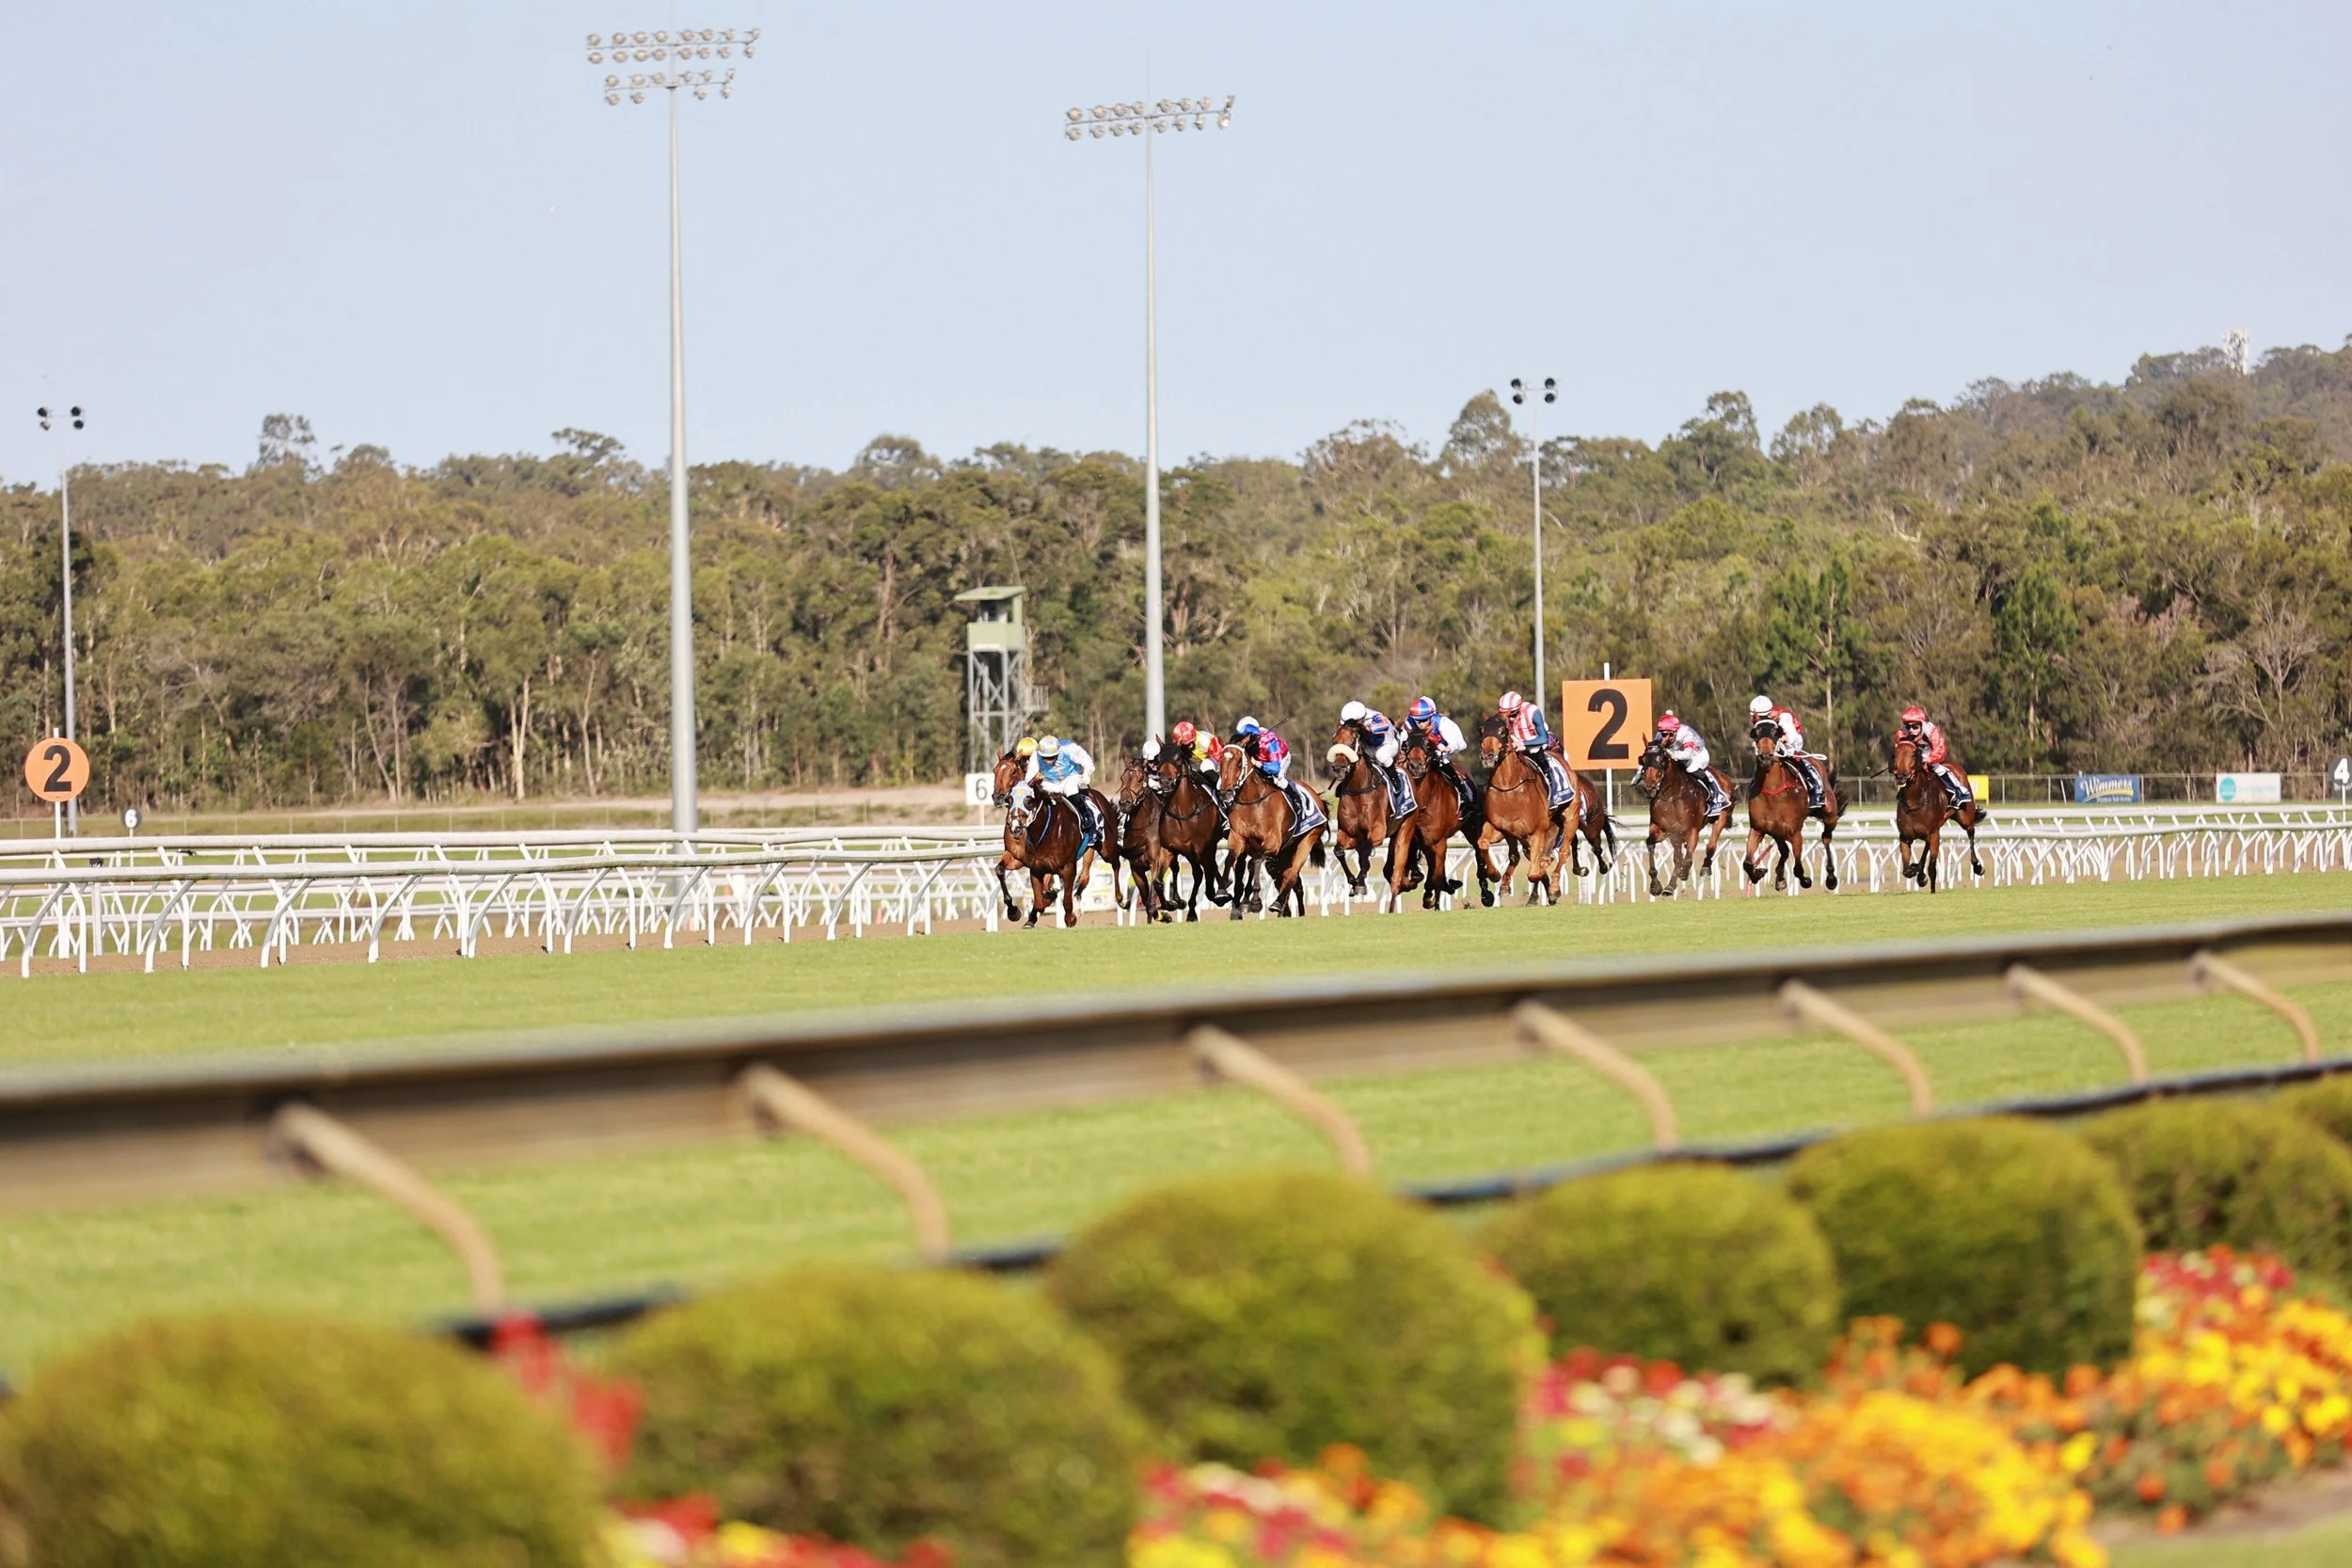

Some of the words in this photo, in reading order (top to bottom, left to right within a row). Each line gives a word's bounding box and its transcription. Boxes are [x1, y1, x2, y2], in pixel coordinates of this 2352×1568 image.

[1587, 689, 1629, 760] 2
[43, 745, 72, 792] 2
[2334, 757, 2350, 784] 4
[976, 778, 988, 800] 6
[124, 809, 137, 828] 6
